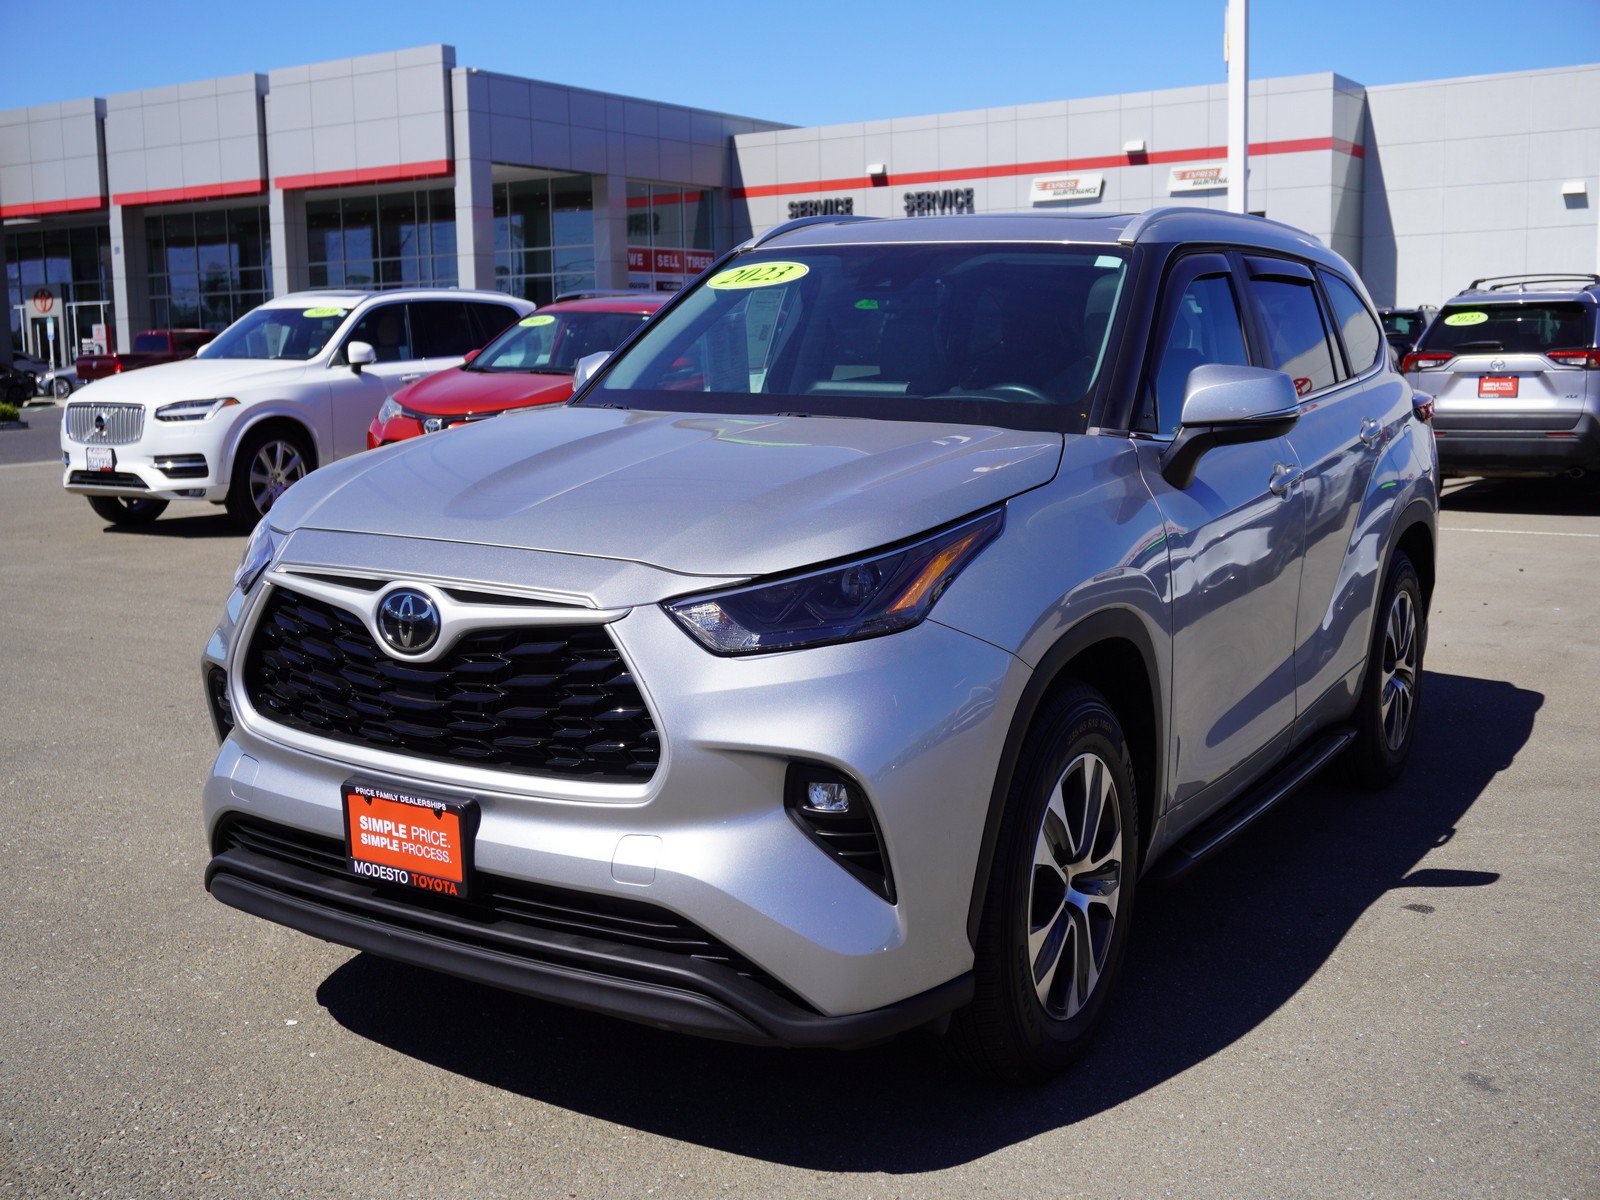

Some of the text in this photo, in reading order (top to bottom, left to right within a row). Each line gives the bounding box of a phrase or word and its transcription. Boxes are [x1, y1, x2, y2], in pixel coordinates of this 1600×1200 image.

[1184, 169, 1218, 179] EXPRESS
[1193, 177, 1229, 186] MAINTENA
[1047, 180, 1077, 190] EXPRESS
[1053, 187, 1097, 196] MAINTENANCE
[788, 198, 853, 219] SERVICE
[904, 188, 974, 213] SERVICE
[628, 253, 643, 266] WE
[657, 254, 680, 268] SELL
[718, 265, 795, 284] 2023
[355, 787, 447, 811] PRICE FAMILY DEALERSHIPS
[360, 815, 451, 848] SIMPLE PRICE.
[361, 833, 452, 864] SIMPLE PROCESS.
[354, 860, 458, 896] MODESTO TOYOTA
